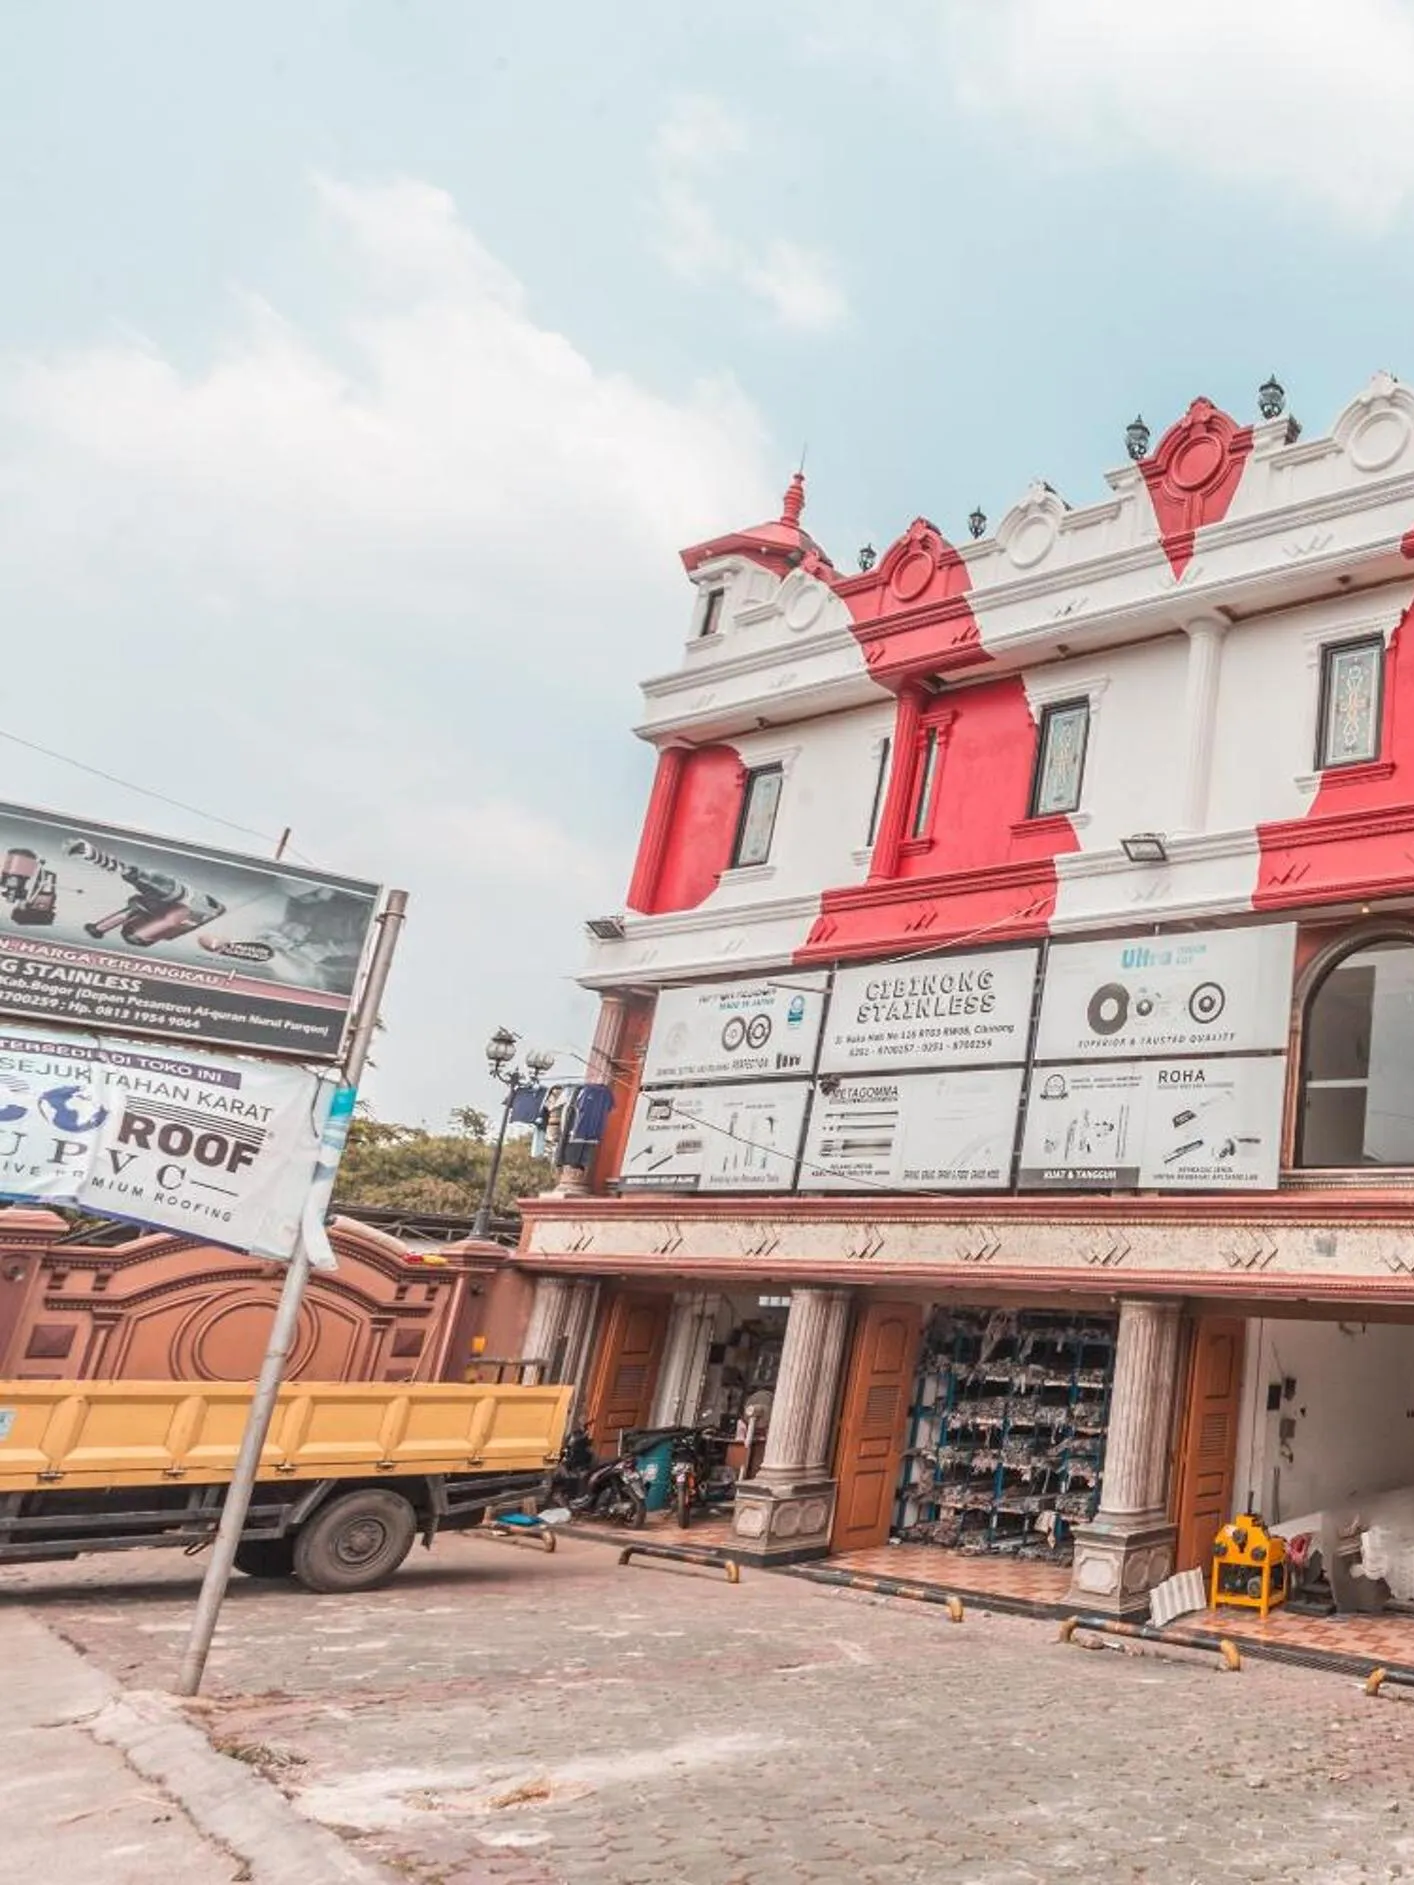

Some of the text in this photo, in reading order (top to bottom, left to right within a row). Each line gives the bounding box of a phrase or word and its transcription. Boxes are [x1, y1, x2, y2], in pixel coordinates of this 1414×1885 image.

[21, 942, 90, 963] HARGA
[99, 957, 218, 985] TERJANGKAU
[22, 962, 142, 993] STAINLESS
[866, 969, 994, 1001] CIBINONG
[857, 993, 996, 1024] STAINLESS
[136, 1059, 192, 1075] TOKO
[198, 1069, 222, 1083] INI
[1158, 1069, 1205, 1084] ROHA
[104, 1071, 190, 1101] TAHAN
[197, 1090, 273, 1122] KARAT
[117, 1111, 260, 1174] ROOF
[154, 1193, 233, 1222] ROOFING
